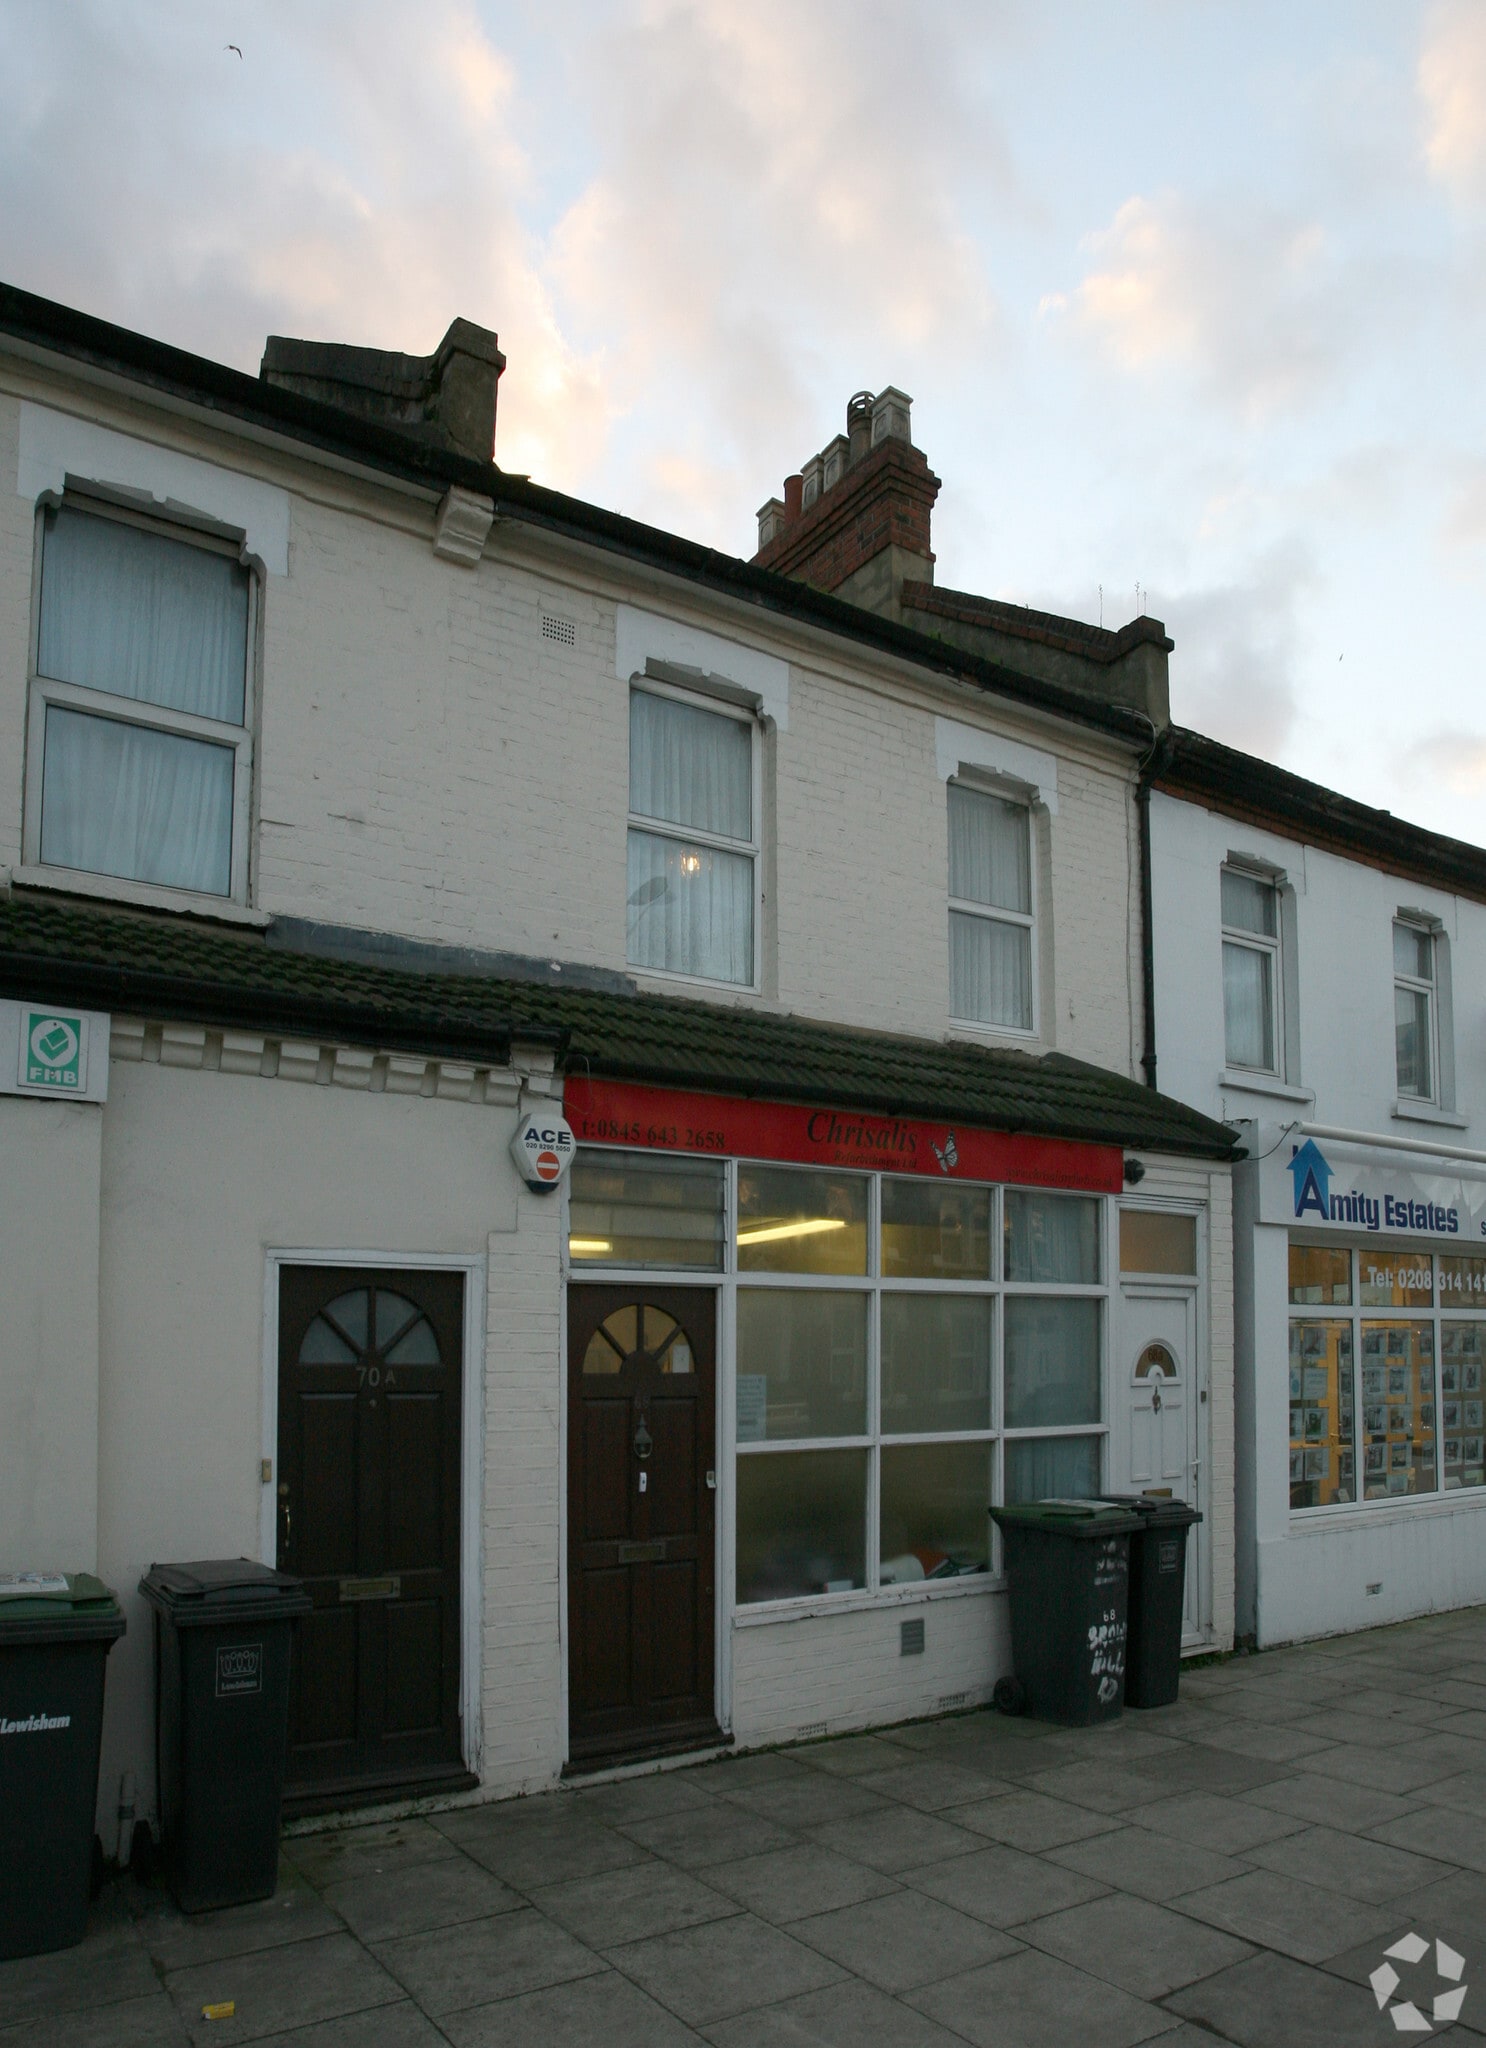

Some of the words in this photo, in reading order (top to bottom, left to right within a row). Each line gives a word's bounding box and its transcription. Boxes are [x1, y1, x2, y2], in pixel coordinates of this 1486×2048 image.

[29, 1067, 77, 1084] FMB
[524, 1128, 571, 1145] ACE
[646, 1126, 678, 1145] 643
[685, 1129, 726, 1150] 2658
[1295, 1164, 1380, 1230] Amity
[1384, 1195, 1459, 1233] Estates
[1367, 1266, 1394, 1288] Tel:
[1397, 1268, 1433, 1290] 0208
[1438, 1271, 1463, 1292] 314
[1103, 1608, 1116, 1622] 68
[0, 1712, 71, 1734] Lewisham
